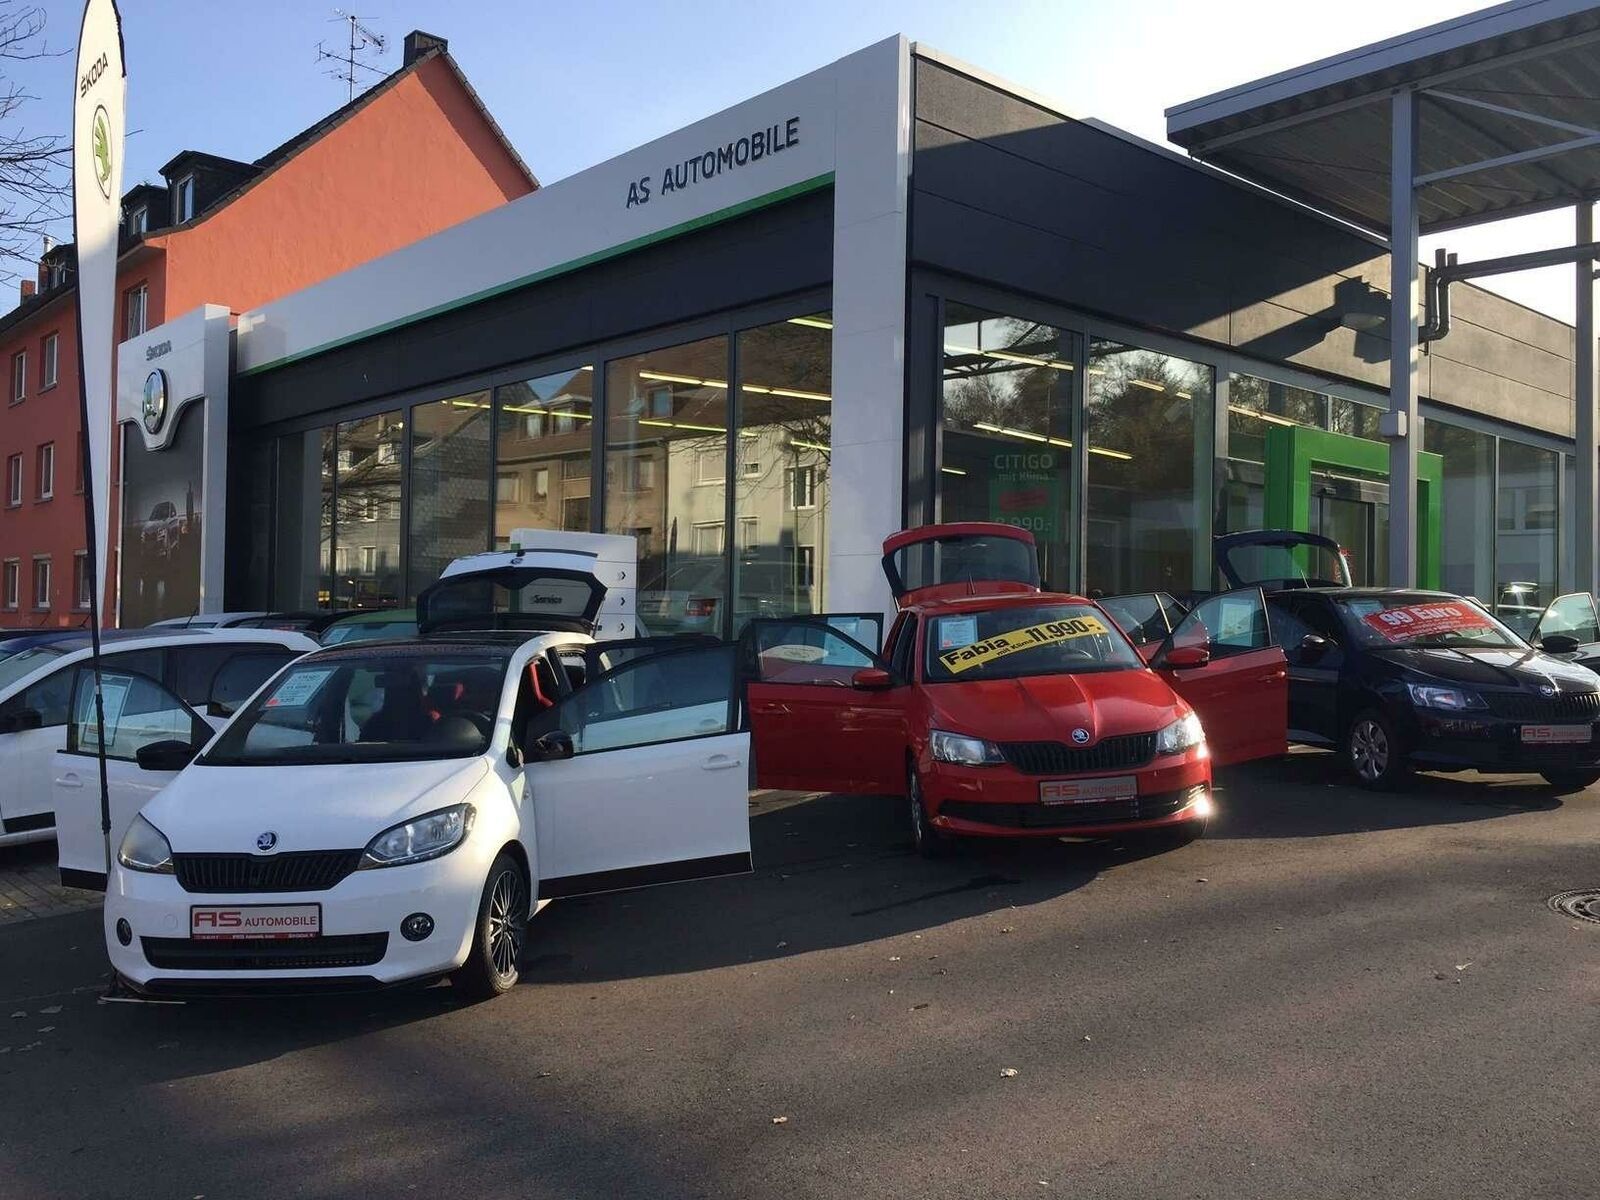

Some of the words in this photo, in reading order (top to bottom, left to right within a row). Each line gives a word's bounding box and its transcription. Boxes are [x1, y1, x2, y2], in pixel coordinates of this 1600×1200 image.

[81, 52, 108, 98] ŠKODA
[626, 176, 651, 209] AS
[661, 116, 800, 196] AUTOMOBILE
[994, 454, 1053, 469] CITIGO
[1379, 610, 1414, 627] 99
[1409, 607, 1463, 620] Euro
[944, 639, 1010, 666] Fabia
[1522, 727, 1551, 738] AS
[1042, 784, 1081, 797] AS
[194, 911, 242, 928] AS
[244, 916, 318, 928] AUTOMOBILE
